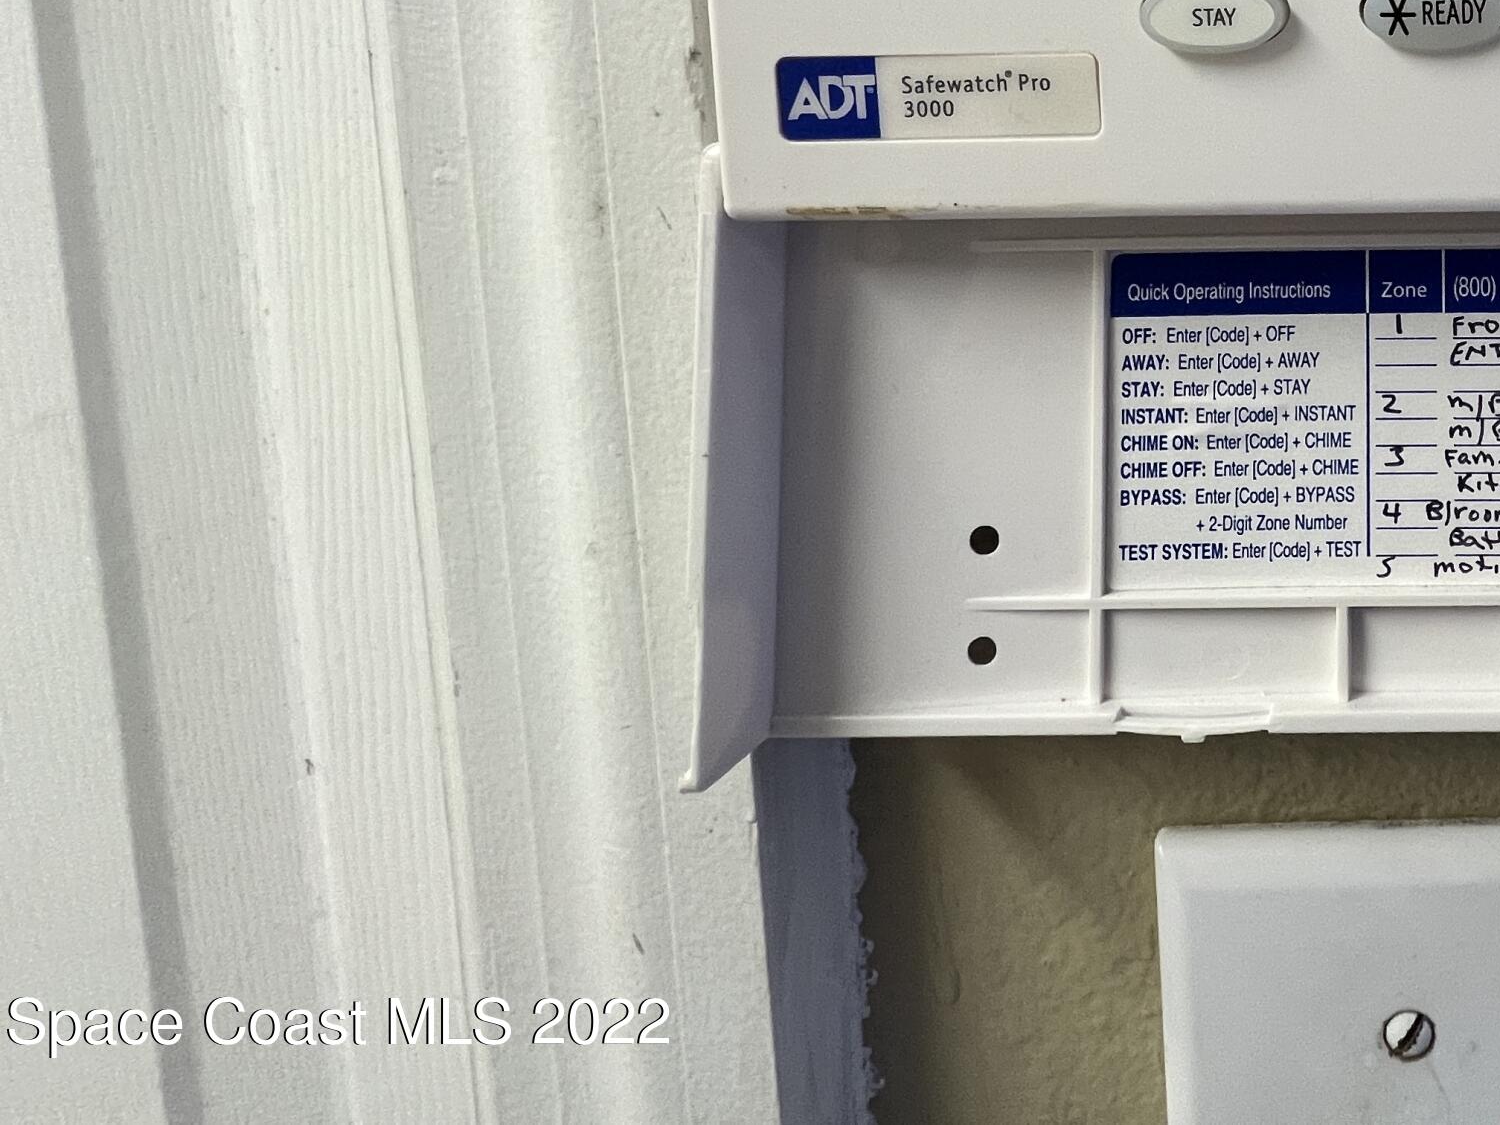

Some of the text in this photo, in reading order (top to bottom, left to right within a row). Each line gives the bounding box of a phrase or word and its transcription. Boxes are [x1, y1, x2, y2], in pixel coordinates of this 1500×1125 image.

[1192, 7, 1236, 27] STAY
[1018, 73, 1051, 93] Pro
[787, 74, 876, 121] ADT
[904, 100, 955, 118] 3000
[1127, 281, 1331, 303] Quick Operating Instructions
[1381, 282, 1427, 298] Zone
[1453, 276, 1496, 301] (800)
[1396, 314, 1403, 334] 1
[1122, 326, 1296, 346] OFF: Enter [Code] + OFF
[1121, 352, 1320, 373] AWAY: Enter [Code] + AWAY
[1121, 379, 1311, 399] STAY: Enter [Code] + STAY
[1381, 394, 1402, 414] 2
[1121, 405, 1356, 426] INSTANT: Enter [Code] + INSTANT
[1120, 432, 1352, 452] CHIME ON: Enter [Code] + CHIME
[1384, 446, 1405, 467] 3
[1120, 459, 1359, 479] CHIME OFF: Enter [Code] + CHIME
[1120, 486, 1355, 507] BYPASS: Enter [Code] + BYPASS
[1382, 503, 1401, 524] 4
[1196, 515, 1348, 535] + 2-Digit Zone Number
[1119, 541, 1361, 561] TEST SYSTEM: Enter [Code] + TEST
